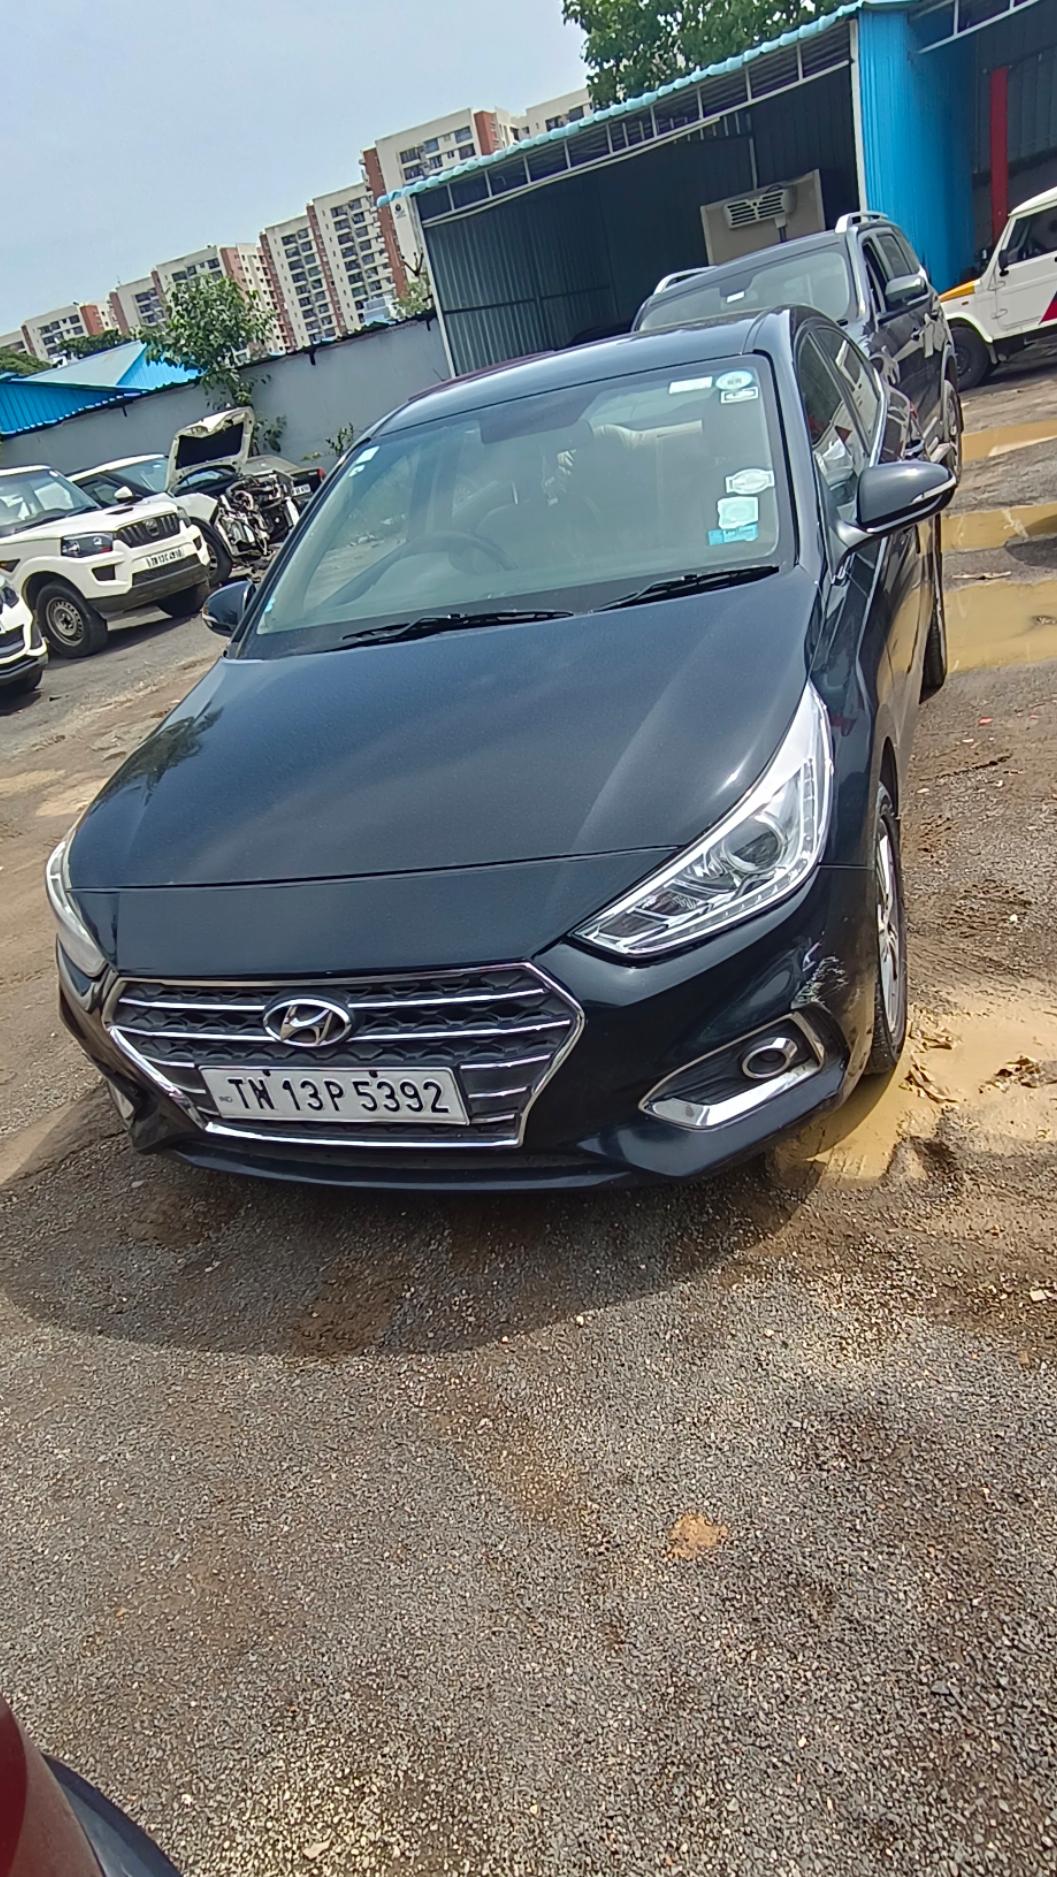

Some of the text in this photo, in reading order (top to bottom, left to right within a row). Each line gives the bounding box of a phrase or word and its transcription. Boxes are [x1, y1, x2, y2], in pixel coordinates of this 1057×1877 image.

[228, 1078, 449, 1113] TN 13P 5392
